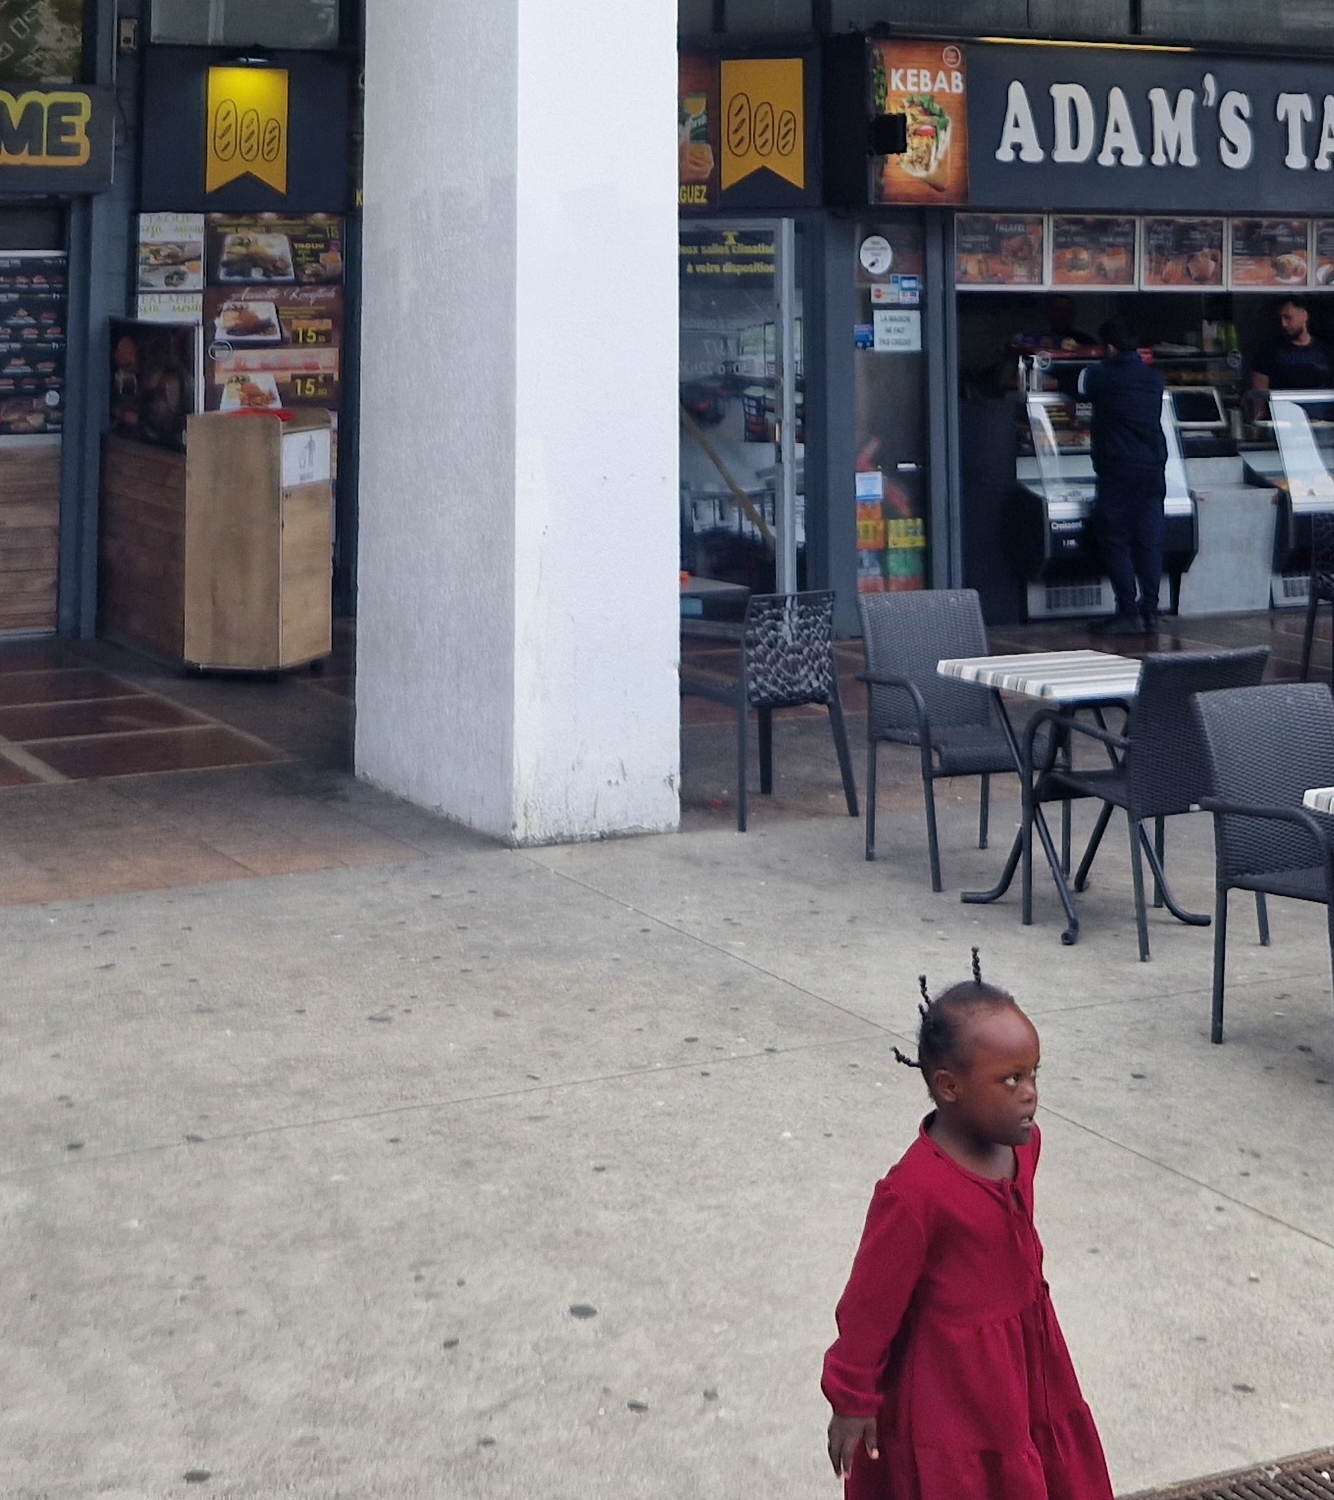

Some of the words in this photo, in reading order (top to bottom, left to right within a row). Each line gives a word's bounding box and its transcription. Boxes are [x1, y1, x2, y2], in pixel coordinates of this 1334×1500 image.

[890, 68, 965, 94] KEBAB
[996, 73, 1253, 170] ADAM'S
[679, 185, 708, 203] GUEZ
